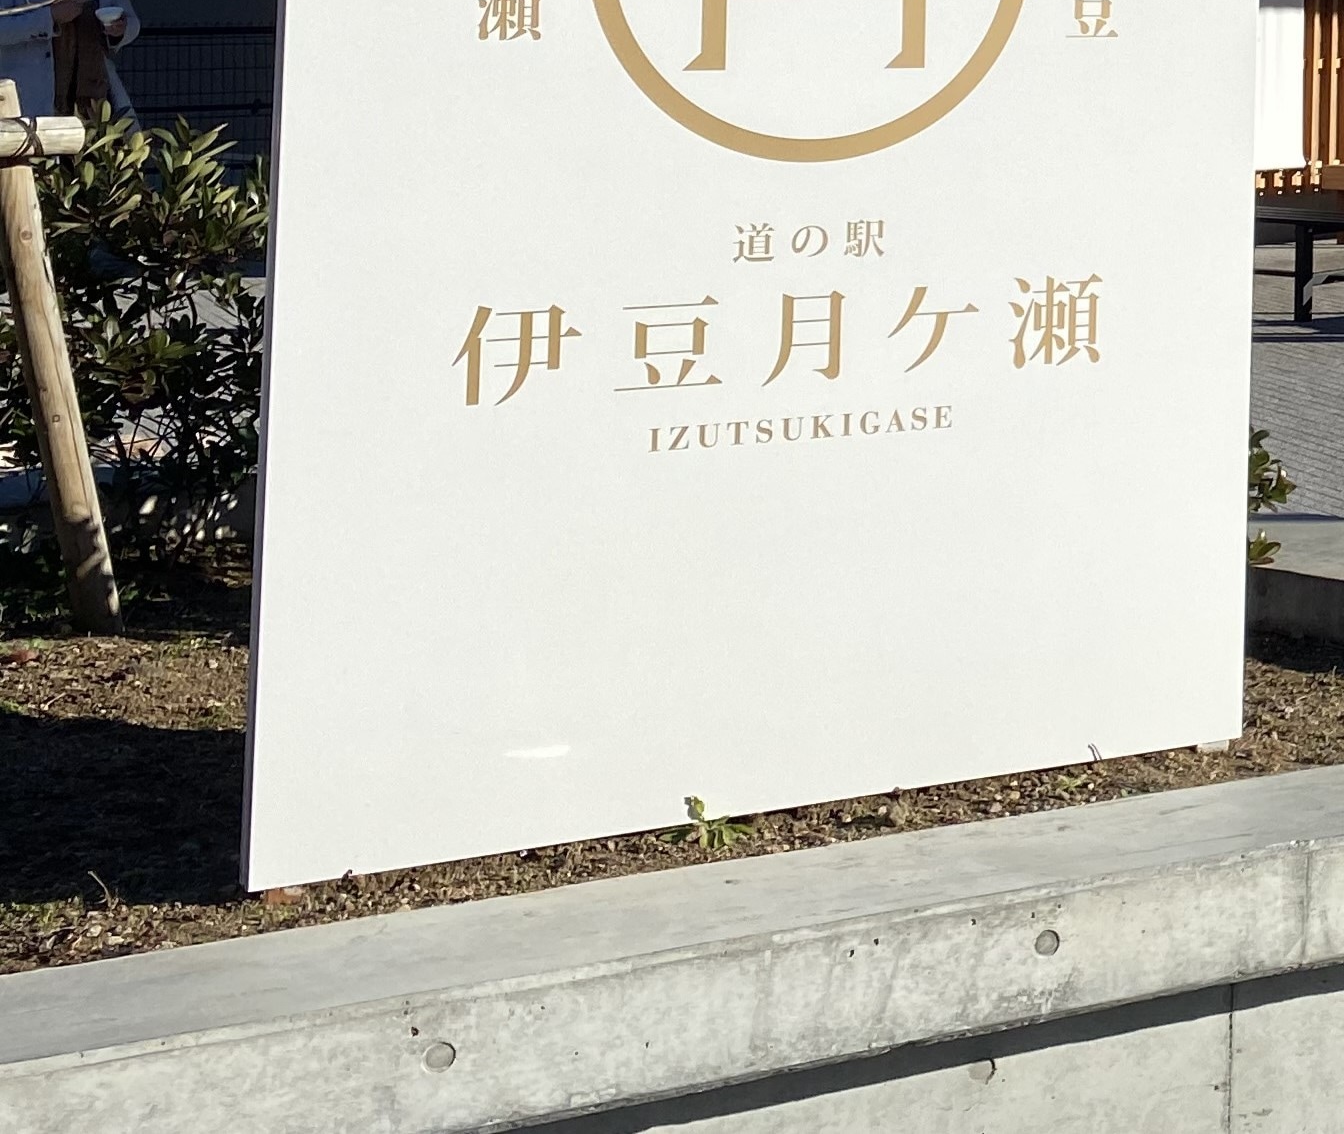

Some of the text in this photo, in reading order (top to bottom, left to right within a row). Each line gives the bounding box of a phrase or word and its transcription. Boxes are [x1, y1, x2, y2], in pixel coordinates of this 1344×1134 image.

[731, 218, 888, 264] 道の駅
[452, 270, 1105, 408] 伊豆月ケ瀬
[647, 404, 955, 453] IZUTSUKIGASE
